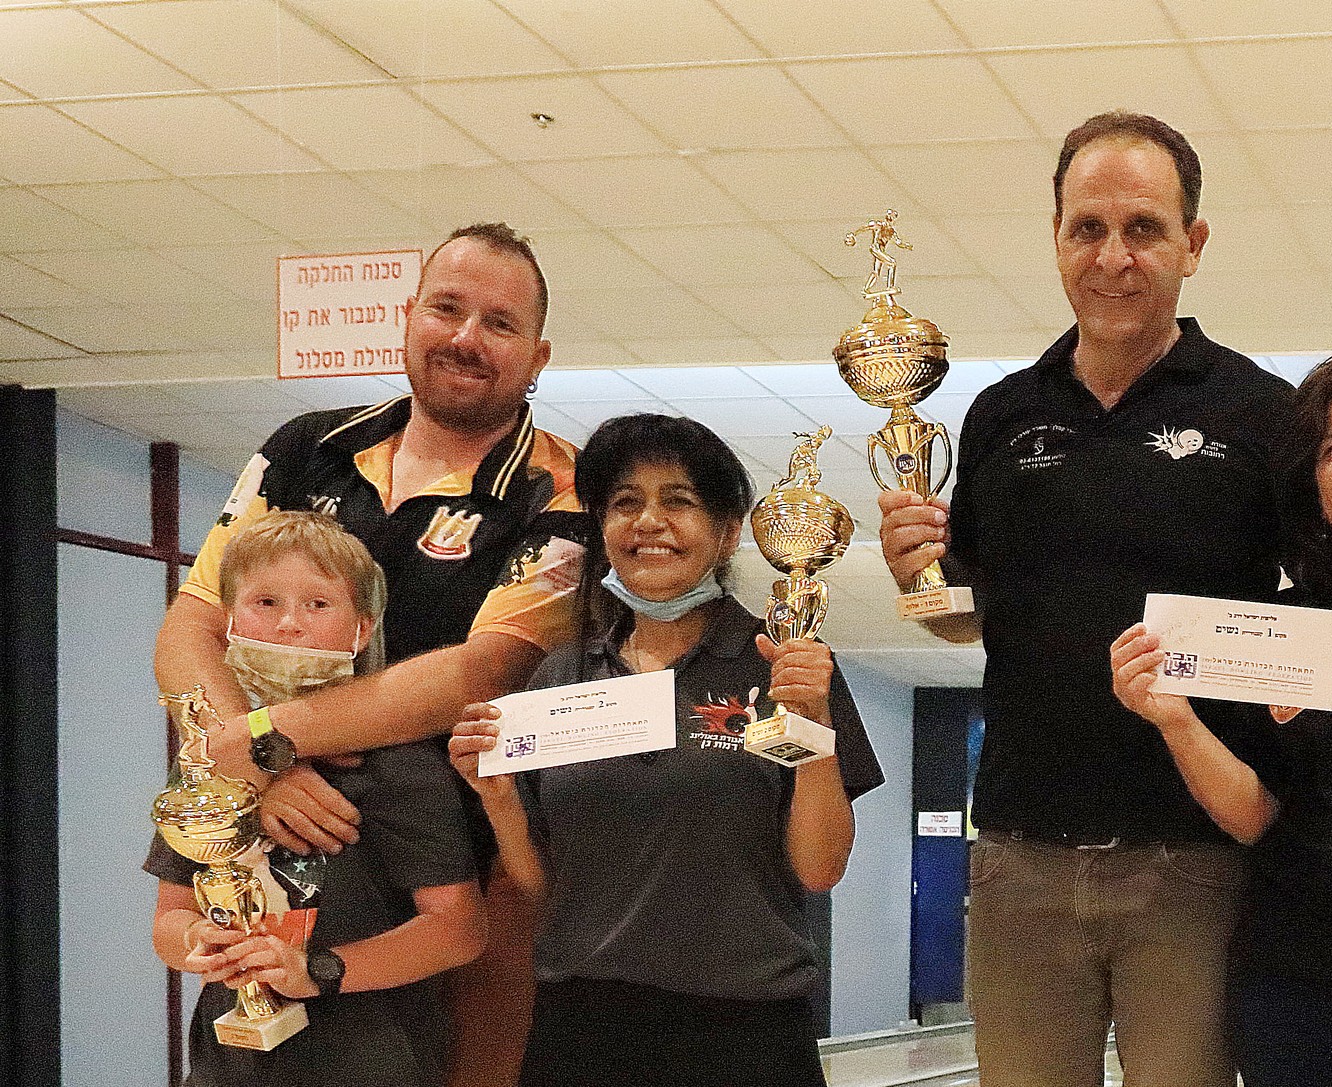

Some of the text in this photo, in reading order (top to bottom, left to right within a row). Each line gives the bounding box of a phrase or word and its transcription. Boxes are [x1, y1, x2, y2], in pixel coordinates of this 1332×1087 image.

[298, 263, 353, 288] החלקה
[283, 310, 300, 332] קו
[308, 308, 330, 326] את
[339, 303, 386, 324] לעבור
[296, 348, 345, 369] מסלול
[1201, 450, 1225, 459] רחובות
[1216, 625, 1238, 634] נשים
[1268, 628, 1272, 637] 1
[550, 707, 571, 715] נשים
[701, 739, 738, 751] רמת גן
